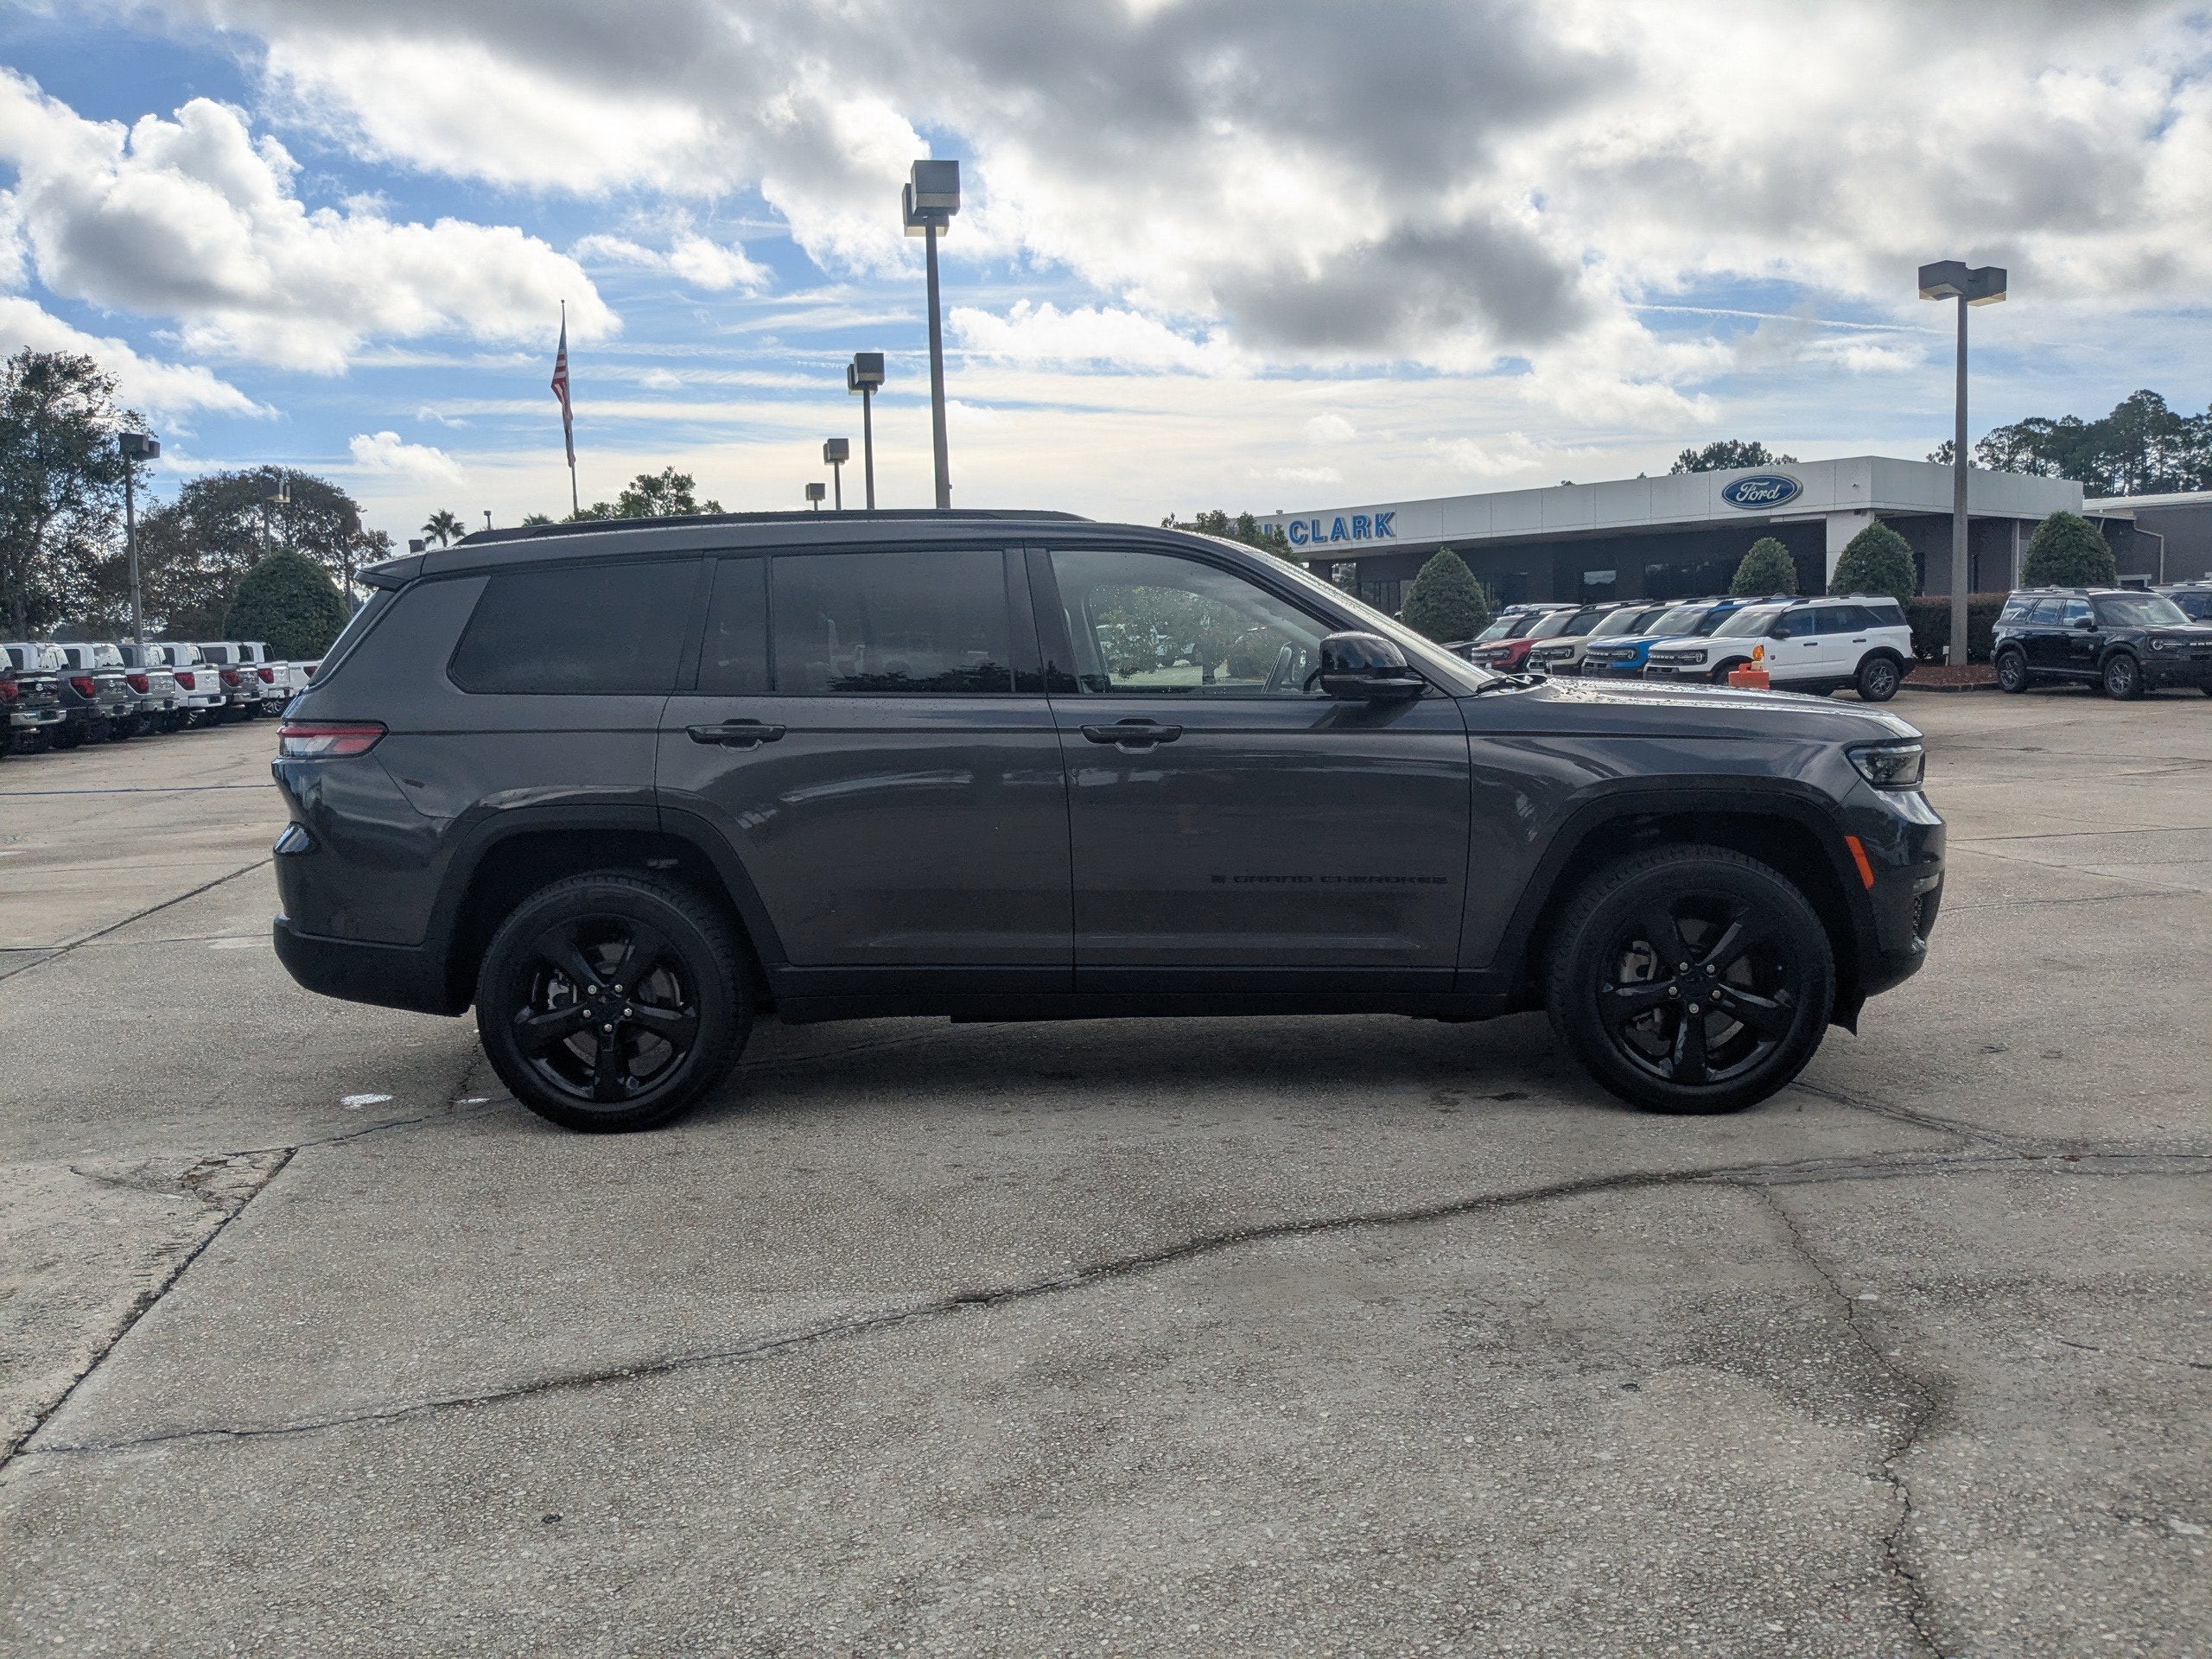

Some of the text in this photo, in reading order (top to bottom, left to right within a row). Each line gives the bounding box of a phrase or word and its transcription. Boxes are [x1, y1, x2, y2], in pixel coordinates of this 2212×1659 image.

[1736, 481, 1781, 501] Ford
[1288, 512, 1395, 545] CLARK
[1233, 874, 1313, 883] GRAND
[1319, 874, 1448, 884] CHEROKEE
